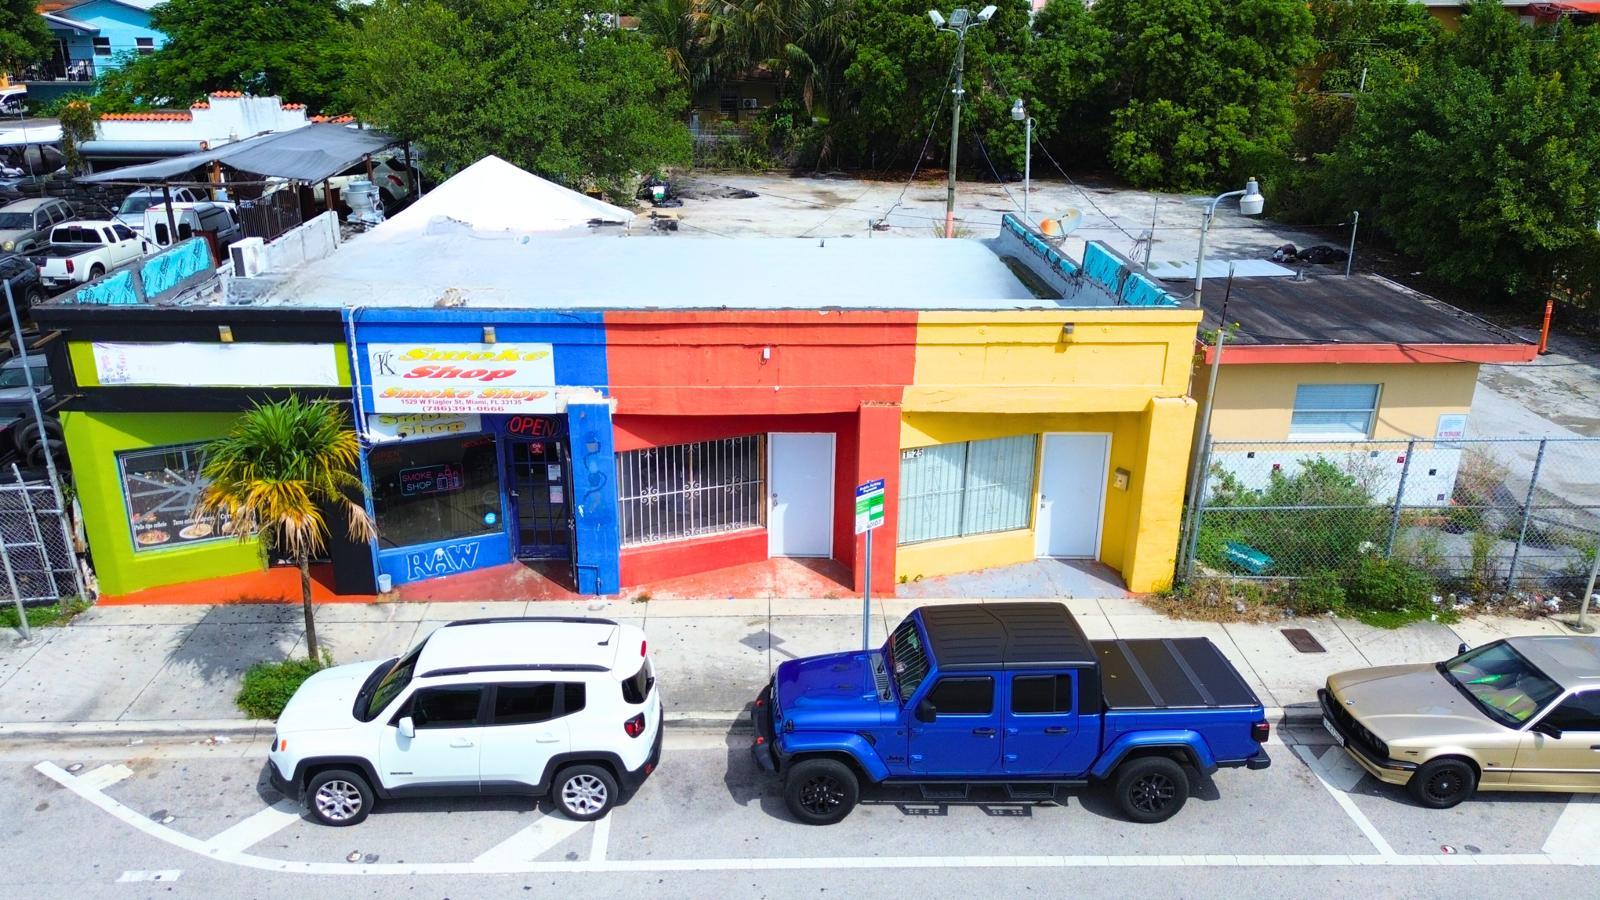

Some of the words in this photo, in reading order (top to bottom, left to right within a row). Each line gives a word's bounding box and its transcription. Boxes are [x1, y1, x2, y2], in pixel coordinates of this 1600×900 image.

[399, 347, 550, 362] Smoke
[402, 364, 518, 382] Shop
[379, 386, 475, 399] Smoke
[477, 387, 550, 401] Shop
[509, 416, 556, 437] OPEN
[402, 471, 433, 482] SMOKE
[406, 481, 432, 492] SHOP
[406, 541, 480, 580] RAW
